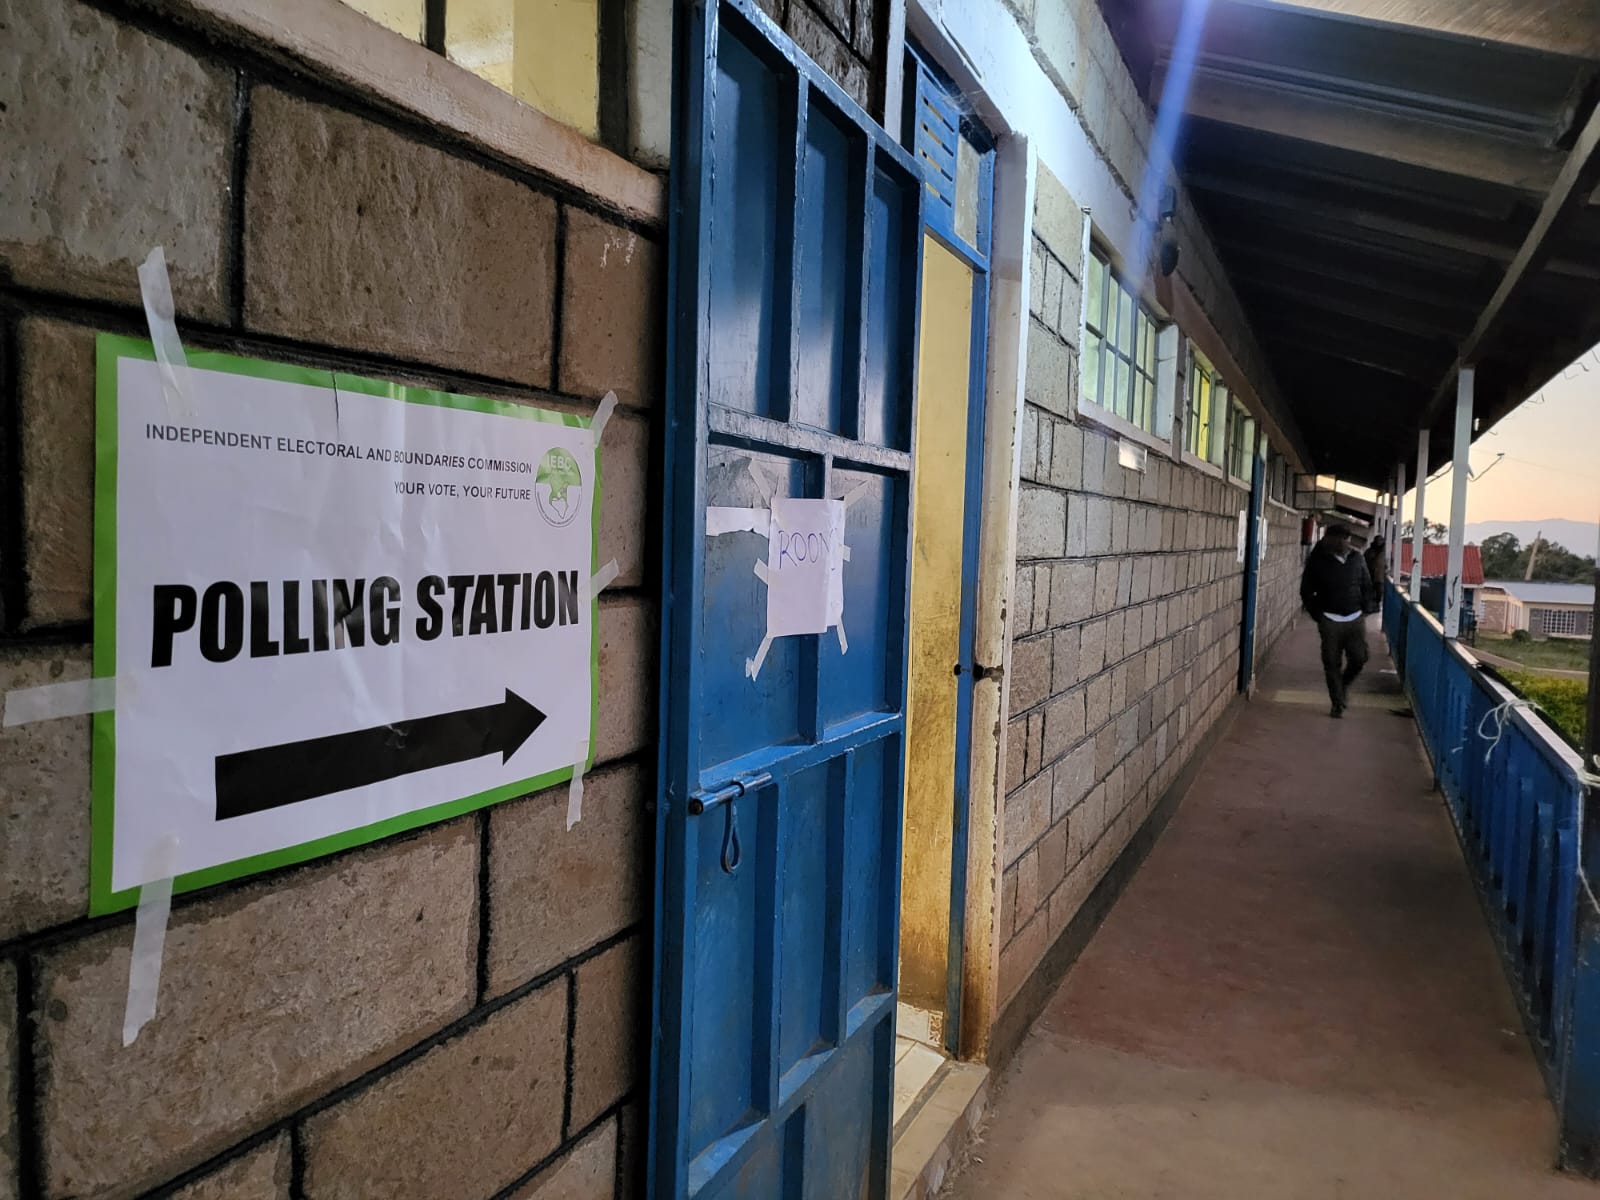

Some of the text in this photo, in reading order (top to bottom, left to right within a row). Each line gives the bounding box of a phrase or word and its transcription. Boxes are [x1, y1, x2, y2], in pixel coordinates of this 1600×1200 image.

[146, 423, 533, 474] INDEPENDENT ELECTORAL AND BOUNDARIES COMMISSION
[394, 481, 532, 501] YOUR VOTE, YOUR FUTURE
[151, 570, 579, 668] POLLING STATION
